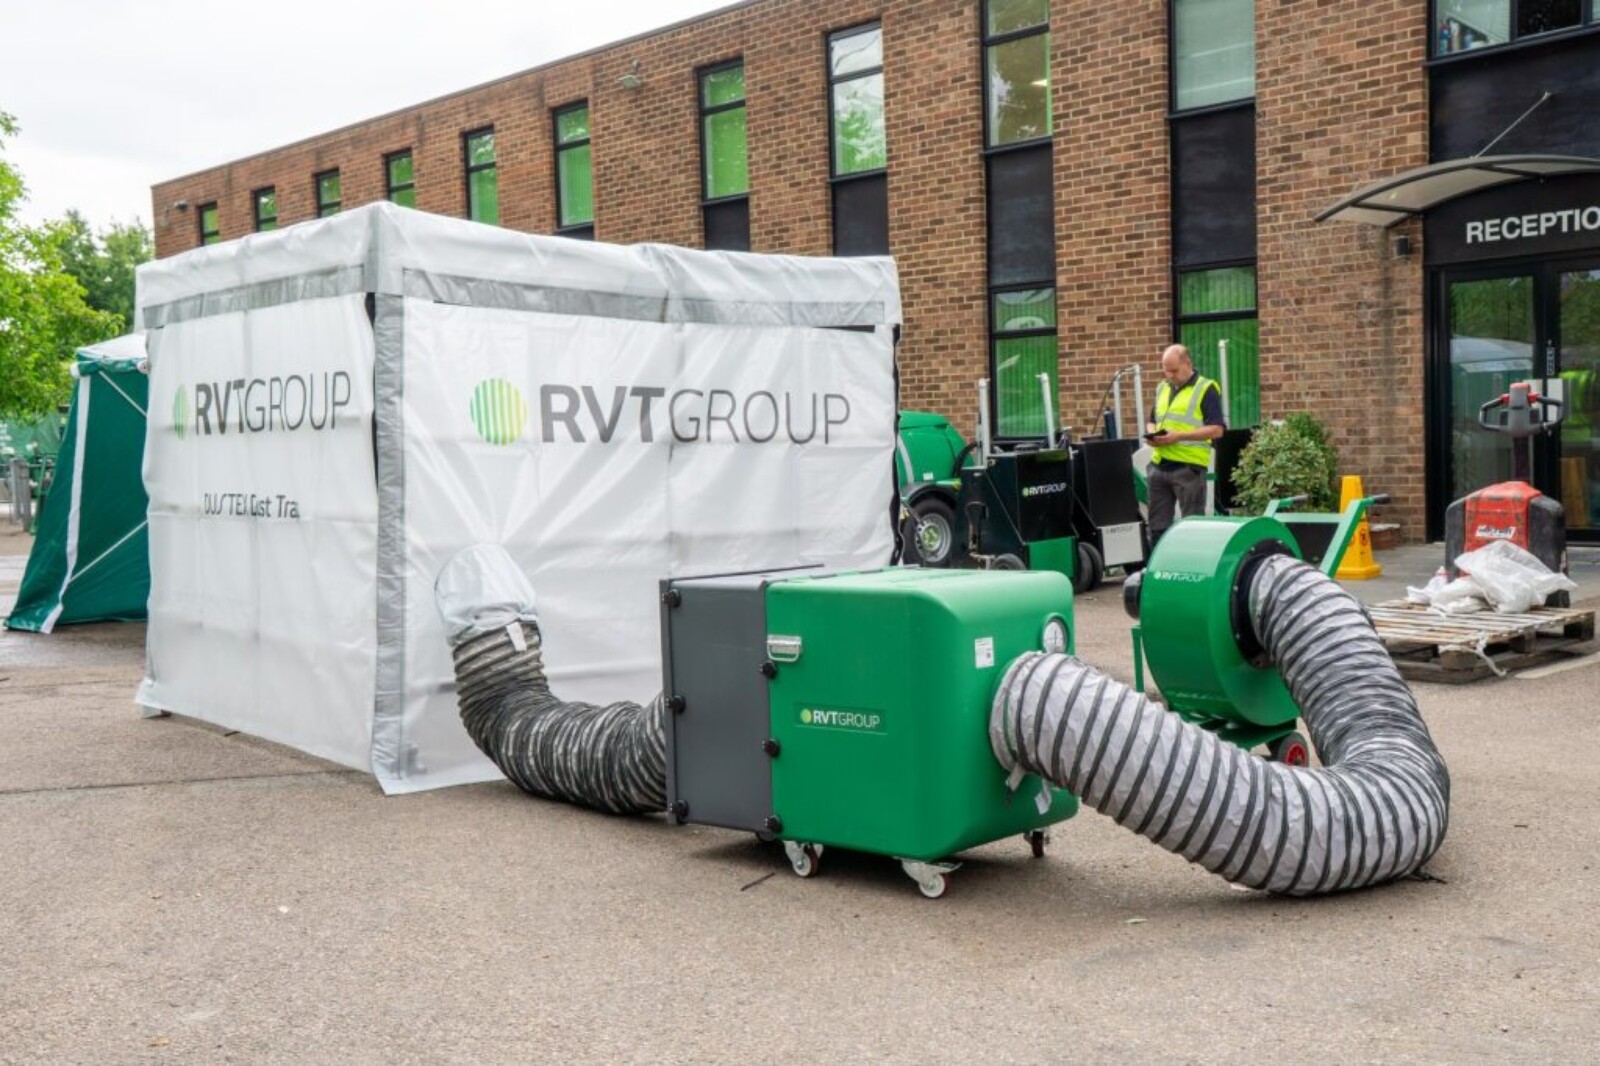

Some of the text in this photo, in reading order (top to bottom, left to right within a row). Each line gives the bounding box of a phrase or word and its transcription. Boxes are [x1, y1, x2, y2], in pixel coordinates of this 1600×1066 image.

[195, 371, 351, 436] RVTGROUP
[540, 384, 850, 445] RVTGROUP
[813, 710, 880, 728] RVTGROUP
